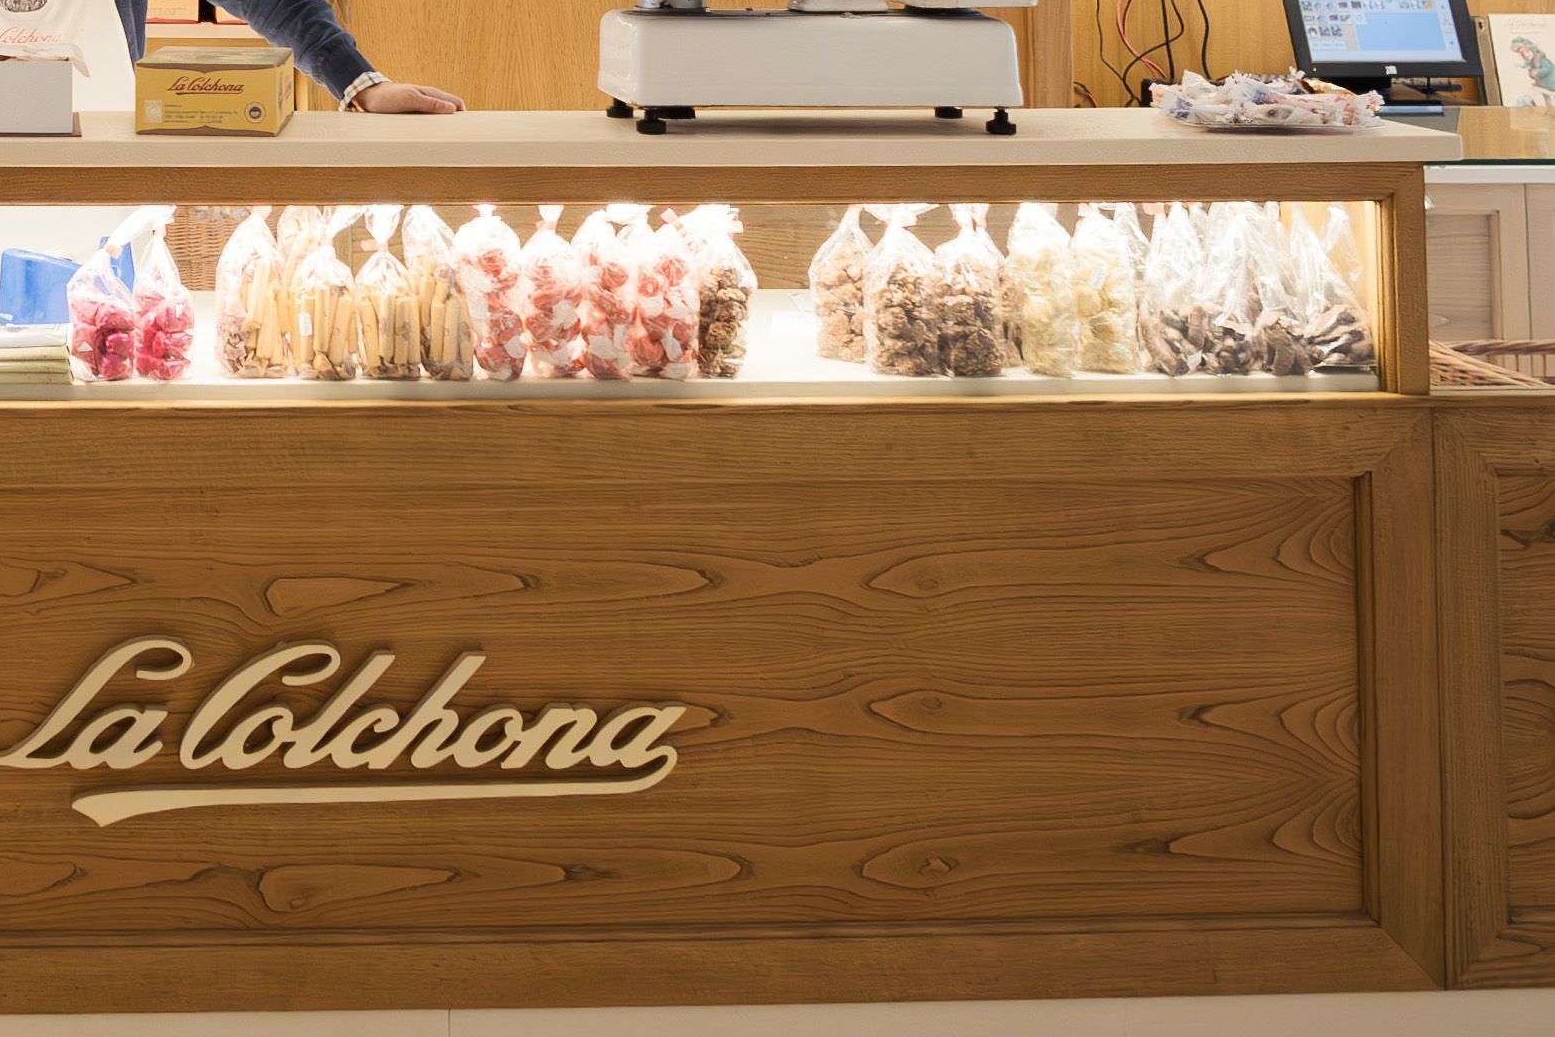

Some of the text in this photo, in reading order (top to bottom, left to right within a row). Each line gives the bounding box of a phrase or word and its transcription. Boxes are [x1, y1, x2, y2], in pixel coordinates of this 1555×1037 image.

[167, 76, 245, 94] La Colchona
[180, 644, 687, 802] Colchona
